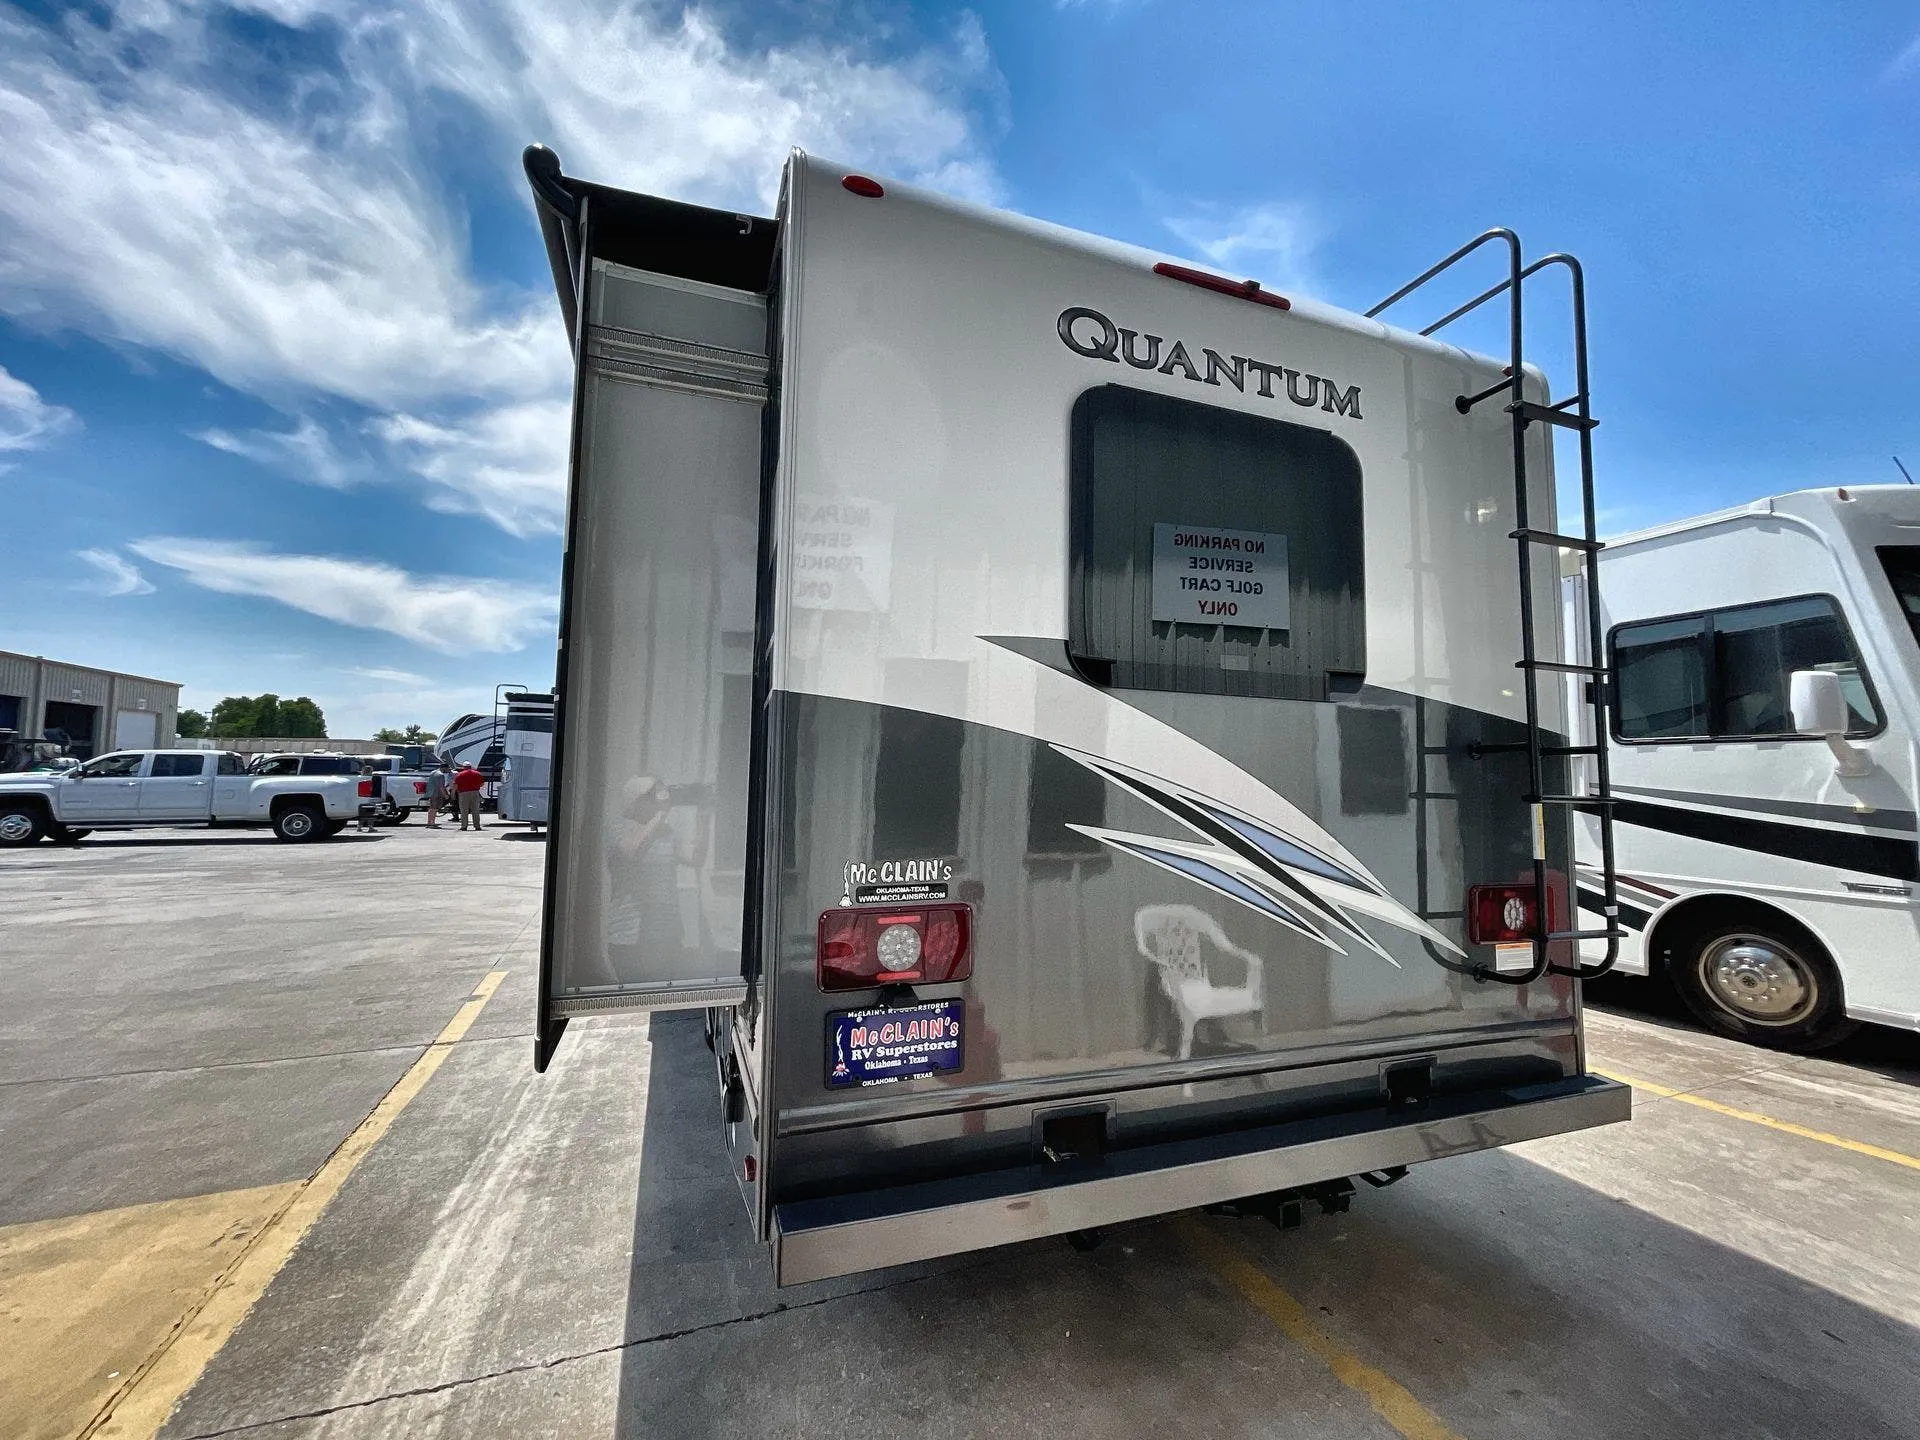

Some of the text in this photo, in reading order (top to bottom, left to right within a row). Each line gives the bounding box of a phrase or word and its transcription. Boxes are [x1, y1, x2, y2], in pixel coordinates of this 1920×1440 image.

[1057, 307, 1363, 420] QUANTUM
[859, 892, 946, 903] WWW.MCCLAINSRV.COM
[850, 1017, 959, 1048] McCLAIN's
[851, 1040, 958, 1060] RV Superstores
[864, 1056, 928, 1070] Oklahoma Texas
[862, 1072, 933, 1087] OKLAHOMA TEXAS
